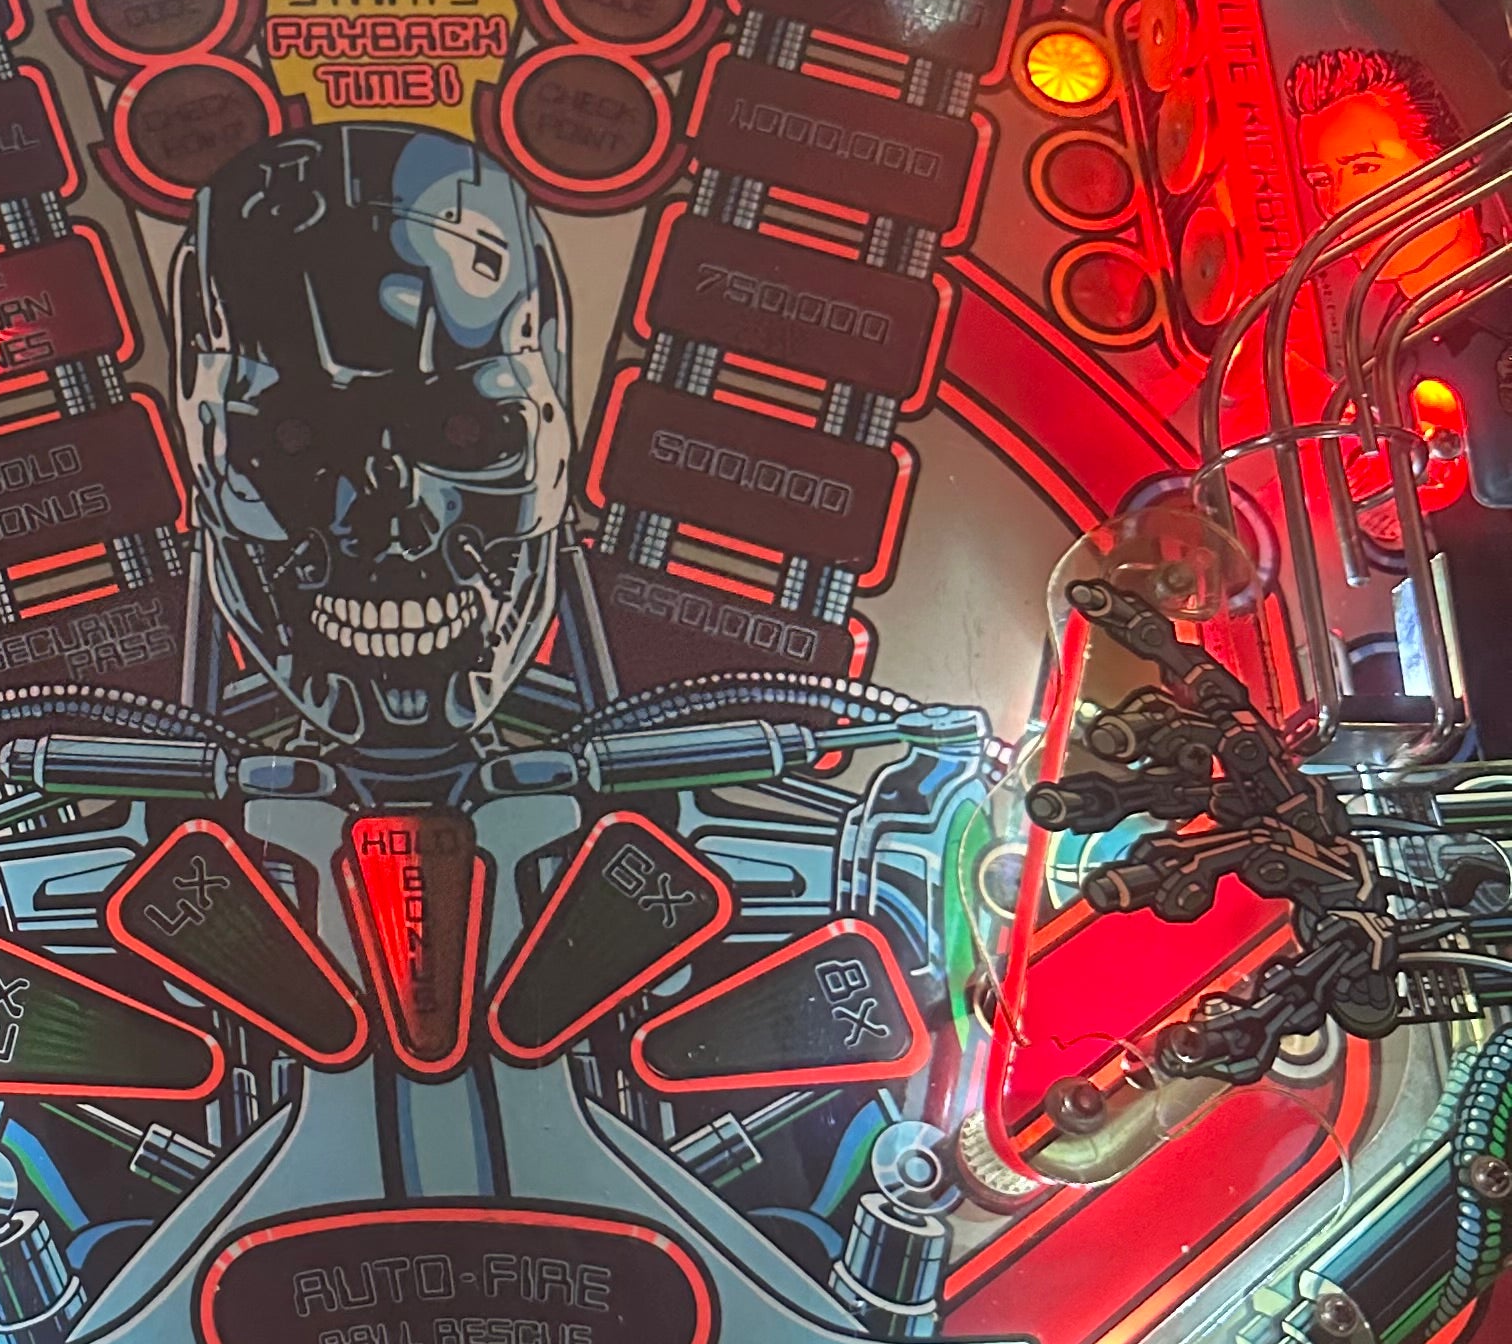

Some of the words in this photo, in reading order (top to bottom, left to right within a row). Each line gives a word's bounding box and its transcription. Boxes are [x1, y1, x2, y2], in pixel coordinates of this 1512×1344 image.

[266, 15, 510, 58] PAYBACK
[696, 262, 893, 345] 750,000
[649, 429, 853, 517] 500,000
[69, 630, 178, 682] PASS
[611, 574, 818, 662] 250,000
[360, 829, 460, 857] HOLD
[143, 856, 234, 936] 4X
[602, 842, 696, 932] 6X
[813, 959, 893, 1050] 8X
[292, 1253, 612, 1318] AUTO-FIRE
